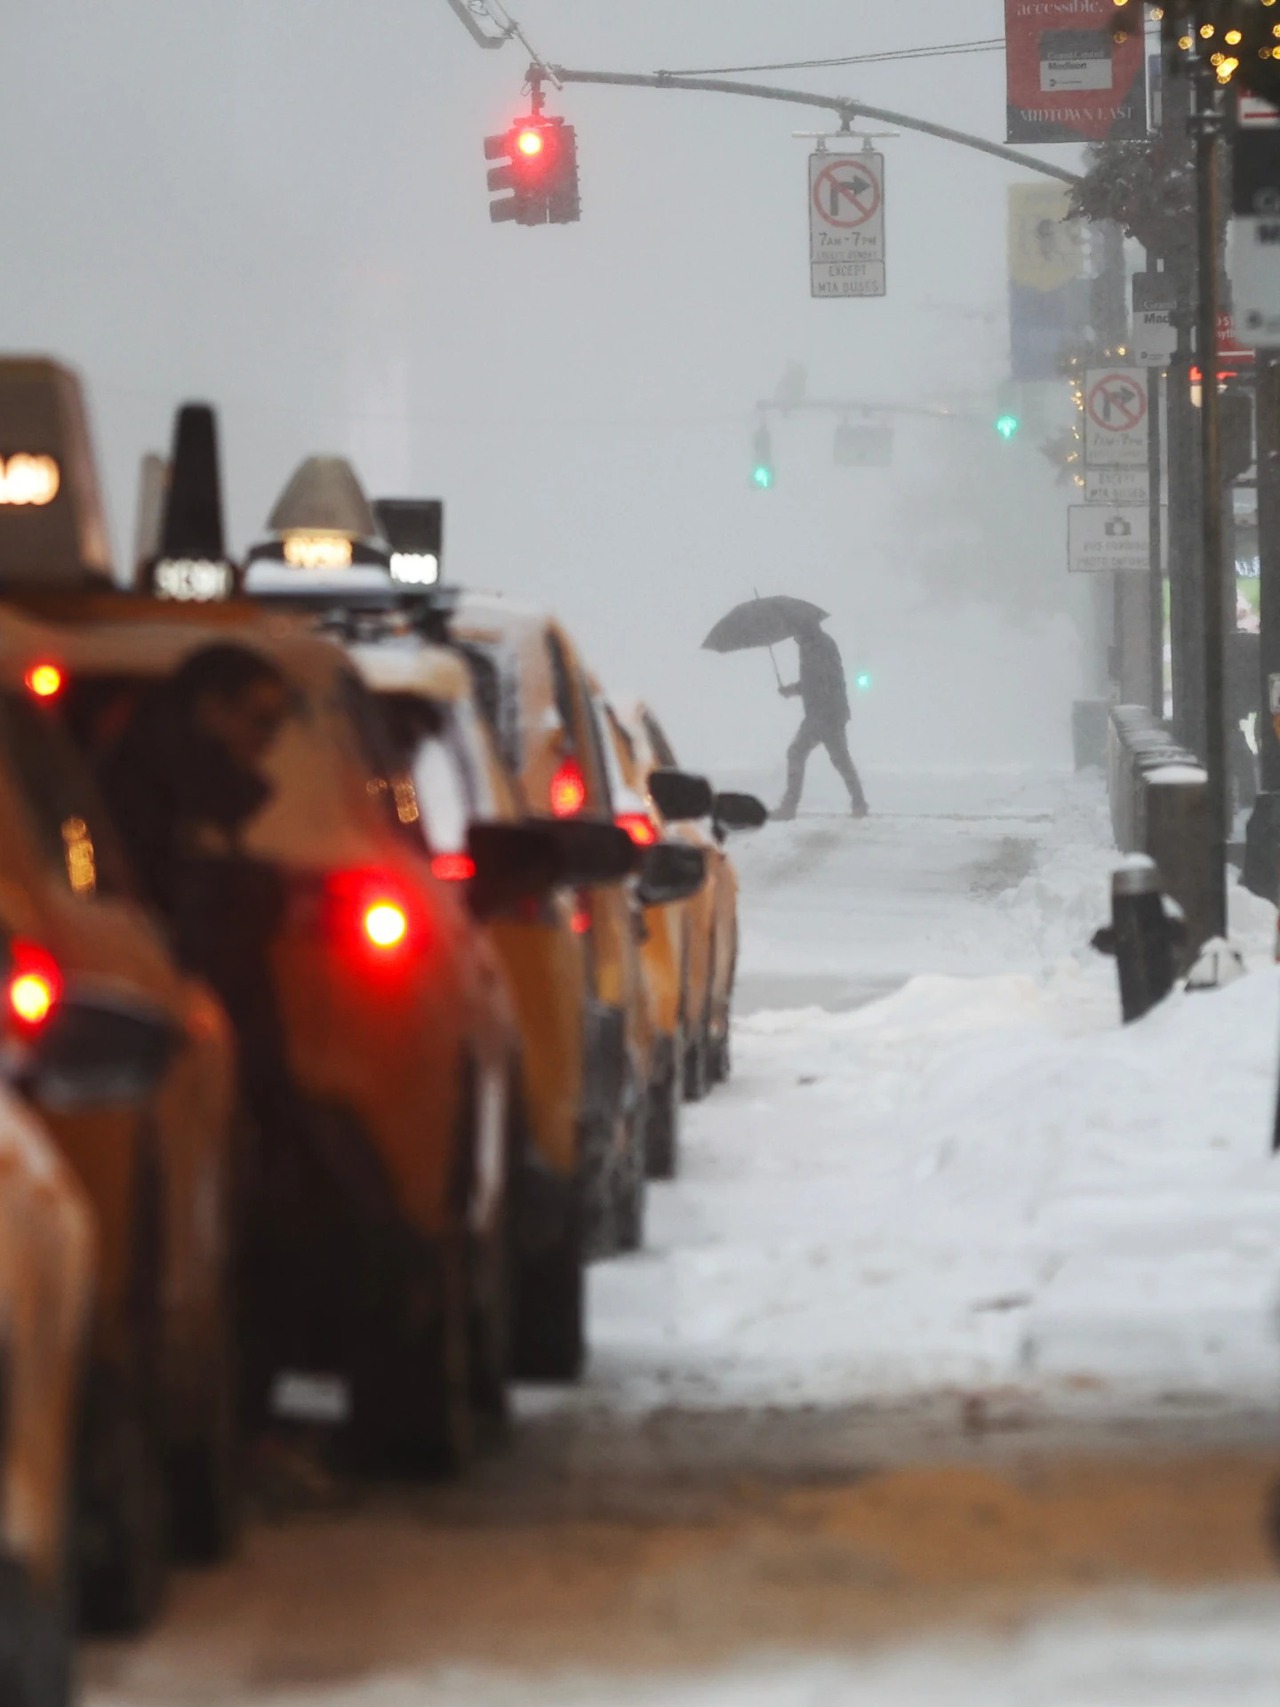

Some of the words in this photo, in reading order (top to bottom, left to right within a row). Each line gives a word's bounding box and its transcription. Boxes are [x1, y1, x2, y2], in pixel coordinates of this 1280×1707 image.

[1017, 0, 1104, 16] accessible.
[1048, 61, 1087, 70] Madison
[1020, 107, 1093, 122] MIDTOWN
[1097, 106, 1134, 121] EAST
[828, 264, 866, 277] EXCEPT
[818, 282, 839, 293] MTA
[842, 280, 880, 293] BUSES
[1144, 300, 1177, 311] Grand
